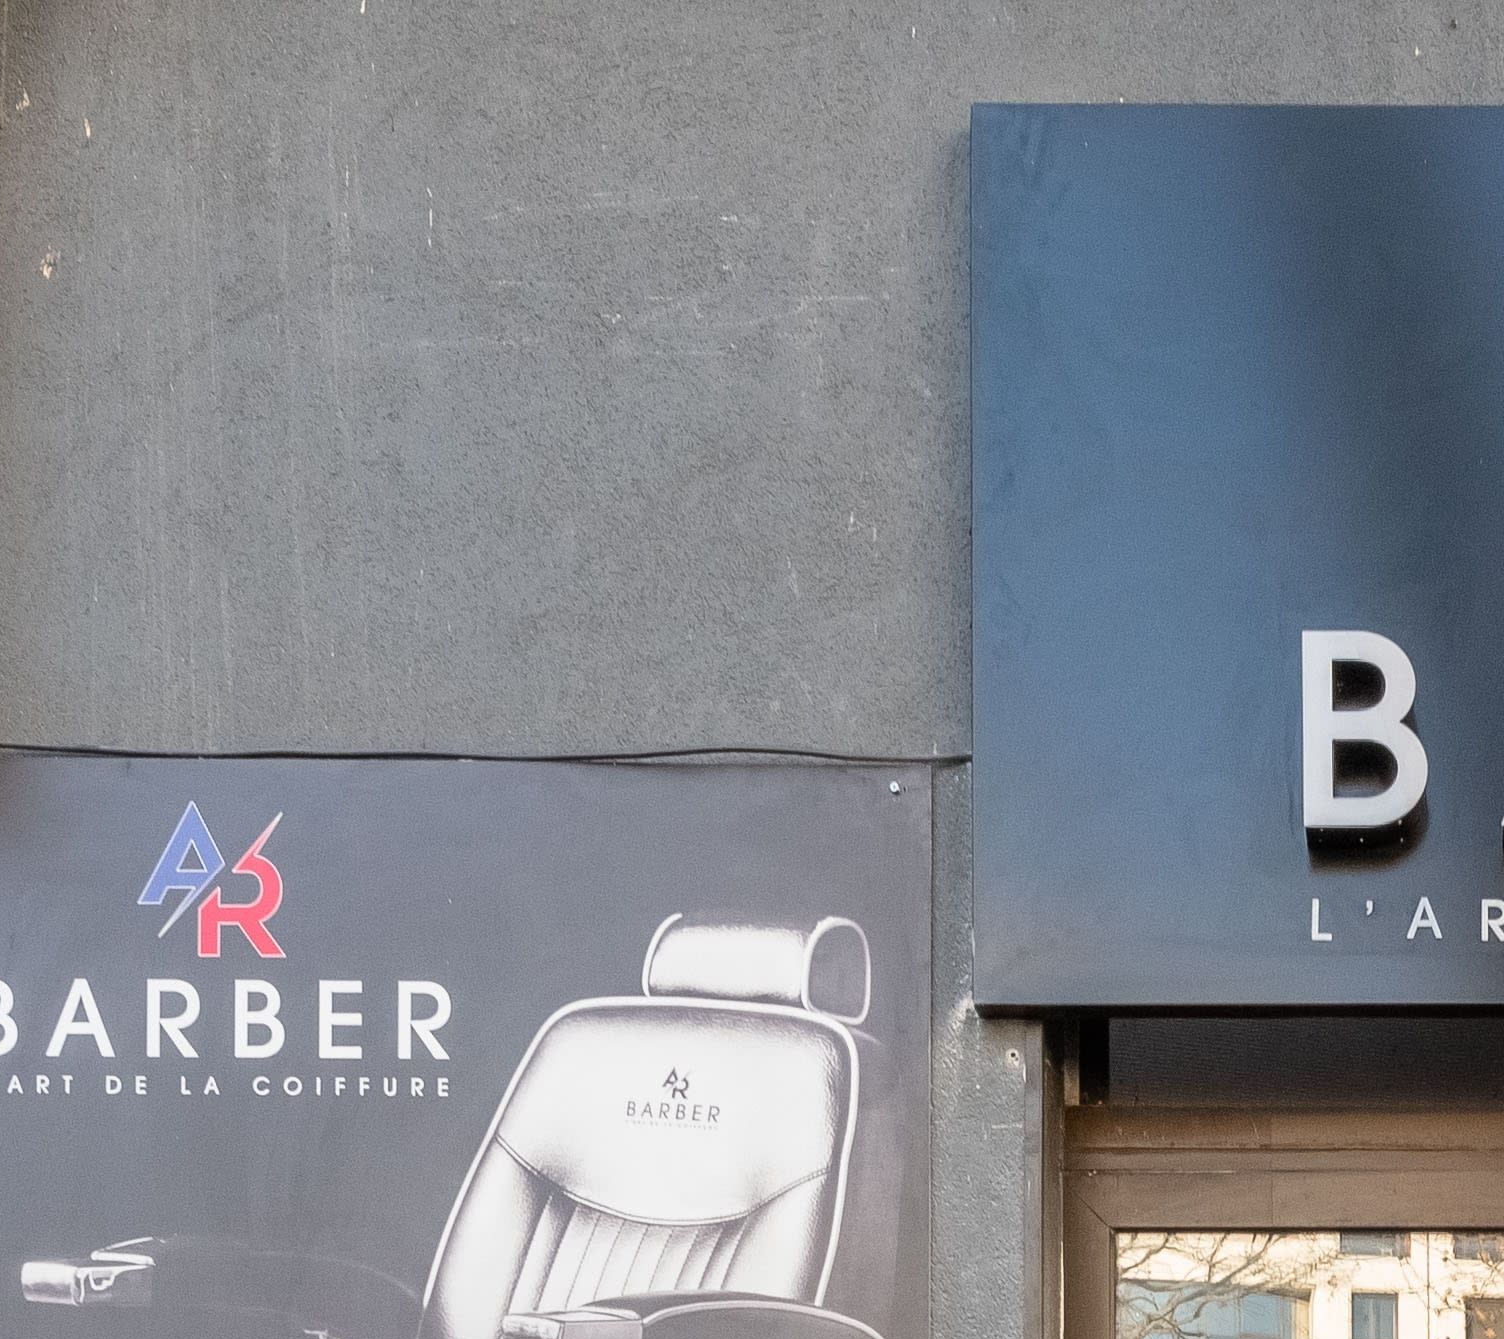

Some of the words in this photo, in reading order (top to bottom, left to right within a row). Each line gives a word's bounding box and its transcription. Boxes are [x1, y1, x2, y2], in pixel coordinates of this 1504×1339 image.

[106, 1076, 146, 1094] DE
[181, 1076, 219, 1094] LA
[253, 1076, 448, 1096] COIFFURE
[626, 1100, 721, 1122] BARBER
